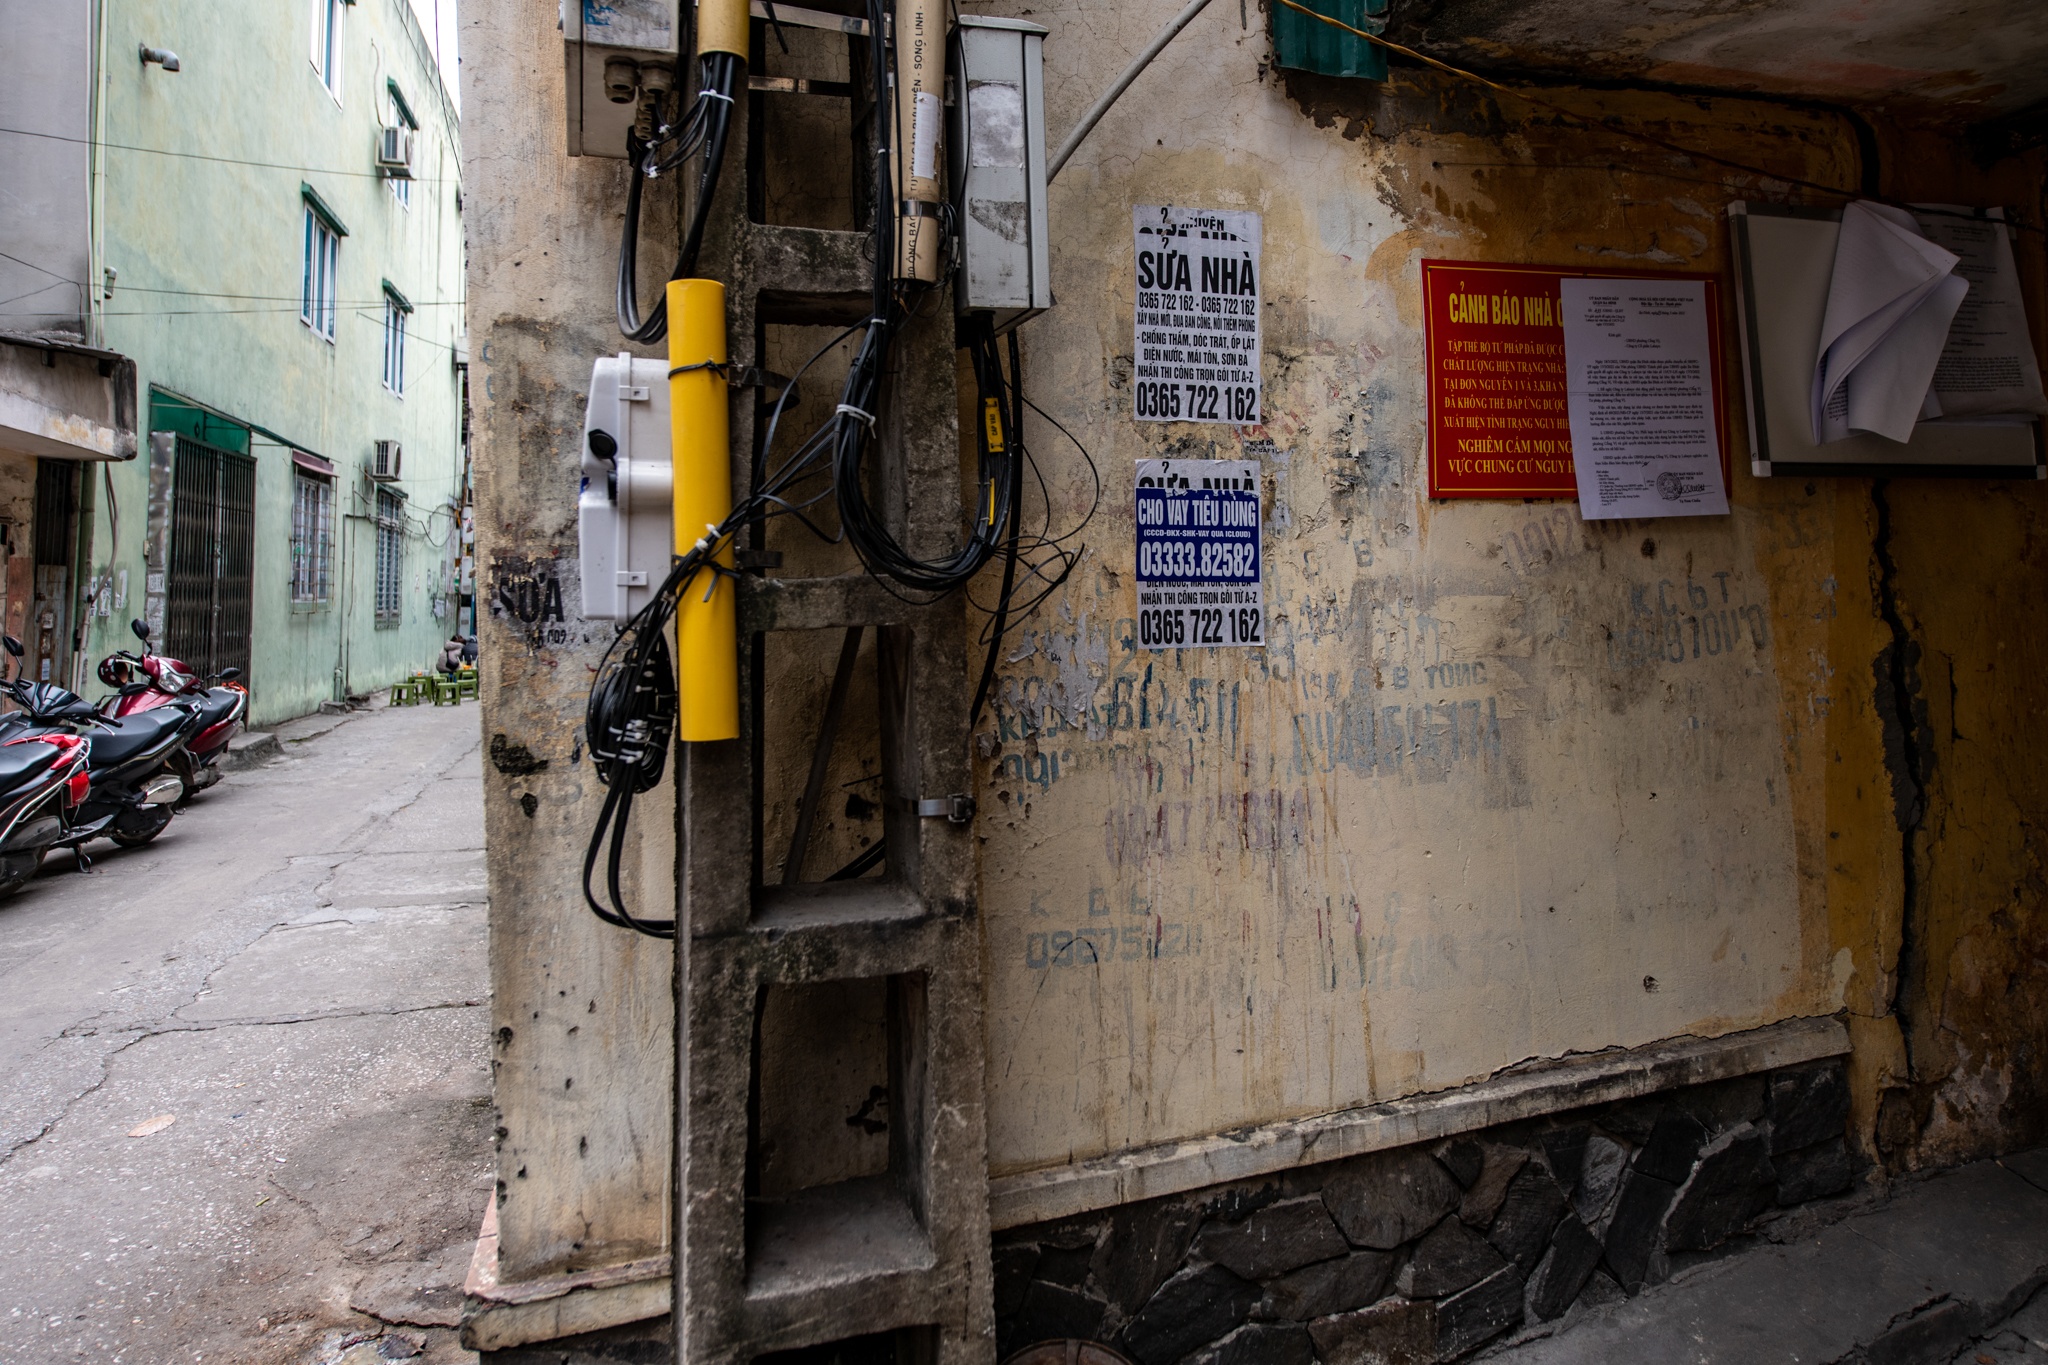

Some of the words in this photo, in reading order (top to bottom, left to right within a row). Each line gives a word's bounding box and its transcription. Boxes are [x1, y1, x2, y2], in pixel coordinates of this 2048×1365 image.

[916, 12, 924, 36] LINH
[914, 40, 923, 70] SONG
[1138, 237, 1192, 292] SỬA
[1202, 251, 1256, 296] NHÀ
[1139, 292, 1159, 309] 0365
[1162, 294, 1176, 310] 722
[1179, 295, 1194, 312] 162
[1202, 296, 1221, 314] 0365
[1224, 298, 1238, 314] 722
[1240, 300, 1255, 316] 162
[1449, 281, 1488, 324] CẢNH
[1492, 289, 1520, 326] BÁO
[1524, 291, 1554, 326] NHÀ
[1184, 315, 1196, 328] BAN
[1142, 328, 1166, 344] CHỐNG
[1169, 330, 1192, 348] THẤM,
[1231, 332, 1240, 349] ỐP
[1242, 336, 1255, 350] LÁT
[1504, 340, 1524, 354] PHÁP
[1536, 342, 1558, 357] ĐƯỢC
[1144, 346, 1160, 363] ĐIỆN
[1163, 347, 1186, 364] NƯỚC,
[1188, 350, 1200, 364] MÁI
[1204, 350, 1220, 366] TÔN,
[1222, 353, 1236, 366] SƠN
[1138, 362, 1158, 380] NHẬN
[1160, 366, 1172, 378] THI
[1174, 365, 1194, 380] CÔNG
[1196, 368, 1215, 383] TRỌN
[1217, 366, 1228, 381] GÓI
[1242, 370, 1254, 383] A-Z
[1466, 359, 1495, 374] LƯỢNG
[1517, 361, 1544, 375] TRẠNG
[1479, 376, 1513, 390] NGUYÊN
[1515, 380, 1518, 391] 1
[1137, 382, 1180, 418] 0365
[1186, 385, 1218, 419] 722
[1224, 387, 1256, 421] 162
[1458, 394, 1488, 408] KHÔNG
[1507, 395, 1522, 409] ĐÁP
[1544, 397, 1566, 412] ĐƯỢC
[1507, 418, 1533, 431] TRẠNG
[1534, 418, 1556, 429] NGUY
[1458, 435, 1504, 453] NGHIÊM
[1534, 440, 1555, 456] MỌI
[1448, 458, 1472, 476] VỰC
[1474, 460, 1514, 473] CHUNG
[1516, 458, 1534, 473] CƯ
[1535, 460, 1566, 474] NGUY
[1138, 498, 1164, 526] CHO
[1167, 499, 1189, 526] VAY
[1192, 495, 1219, 526] TIÊU
[1222, 495, 1256, 526] DÙNG
[1211, 530, 1224, 538] QUA
[1226, 530, 1250, 538] ICLOUD)
[1140, 542, 1254, 577] 03333.82582
[1141, 590, 1162, 607] NHẬN
[1164, 592, 1176, 604] THI
[1178, 590, 1198, 604] CÔNG
[1200, 592, 1218, 606] TRỌN
[1220, 590, 1232, 604] GÓI
[1244, 592, 1257, 604] A-Z
[1140, 609, 1184, 644] 0365
[1190, 608, 1222, 643] 722
[1228, 608, 1260, 642] 162
